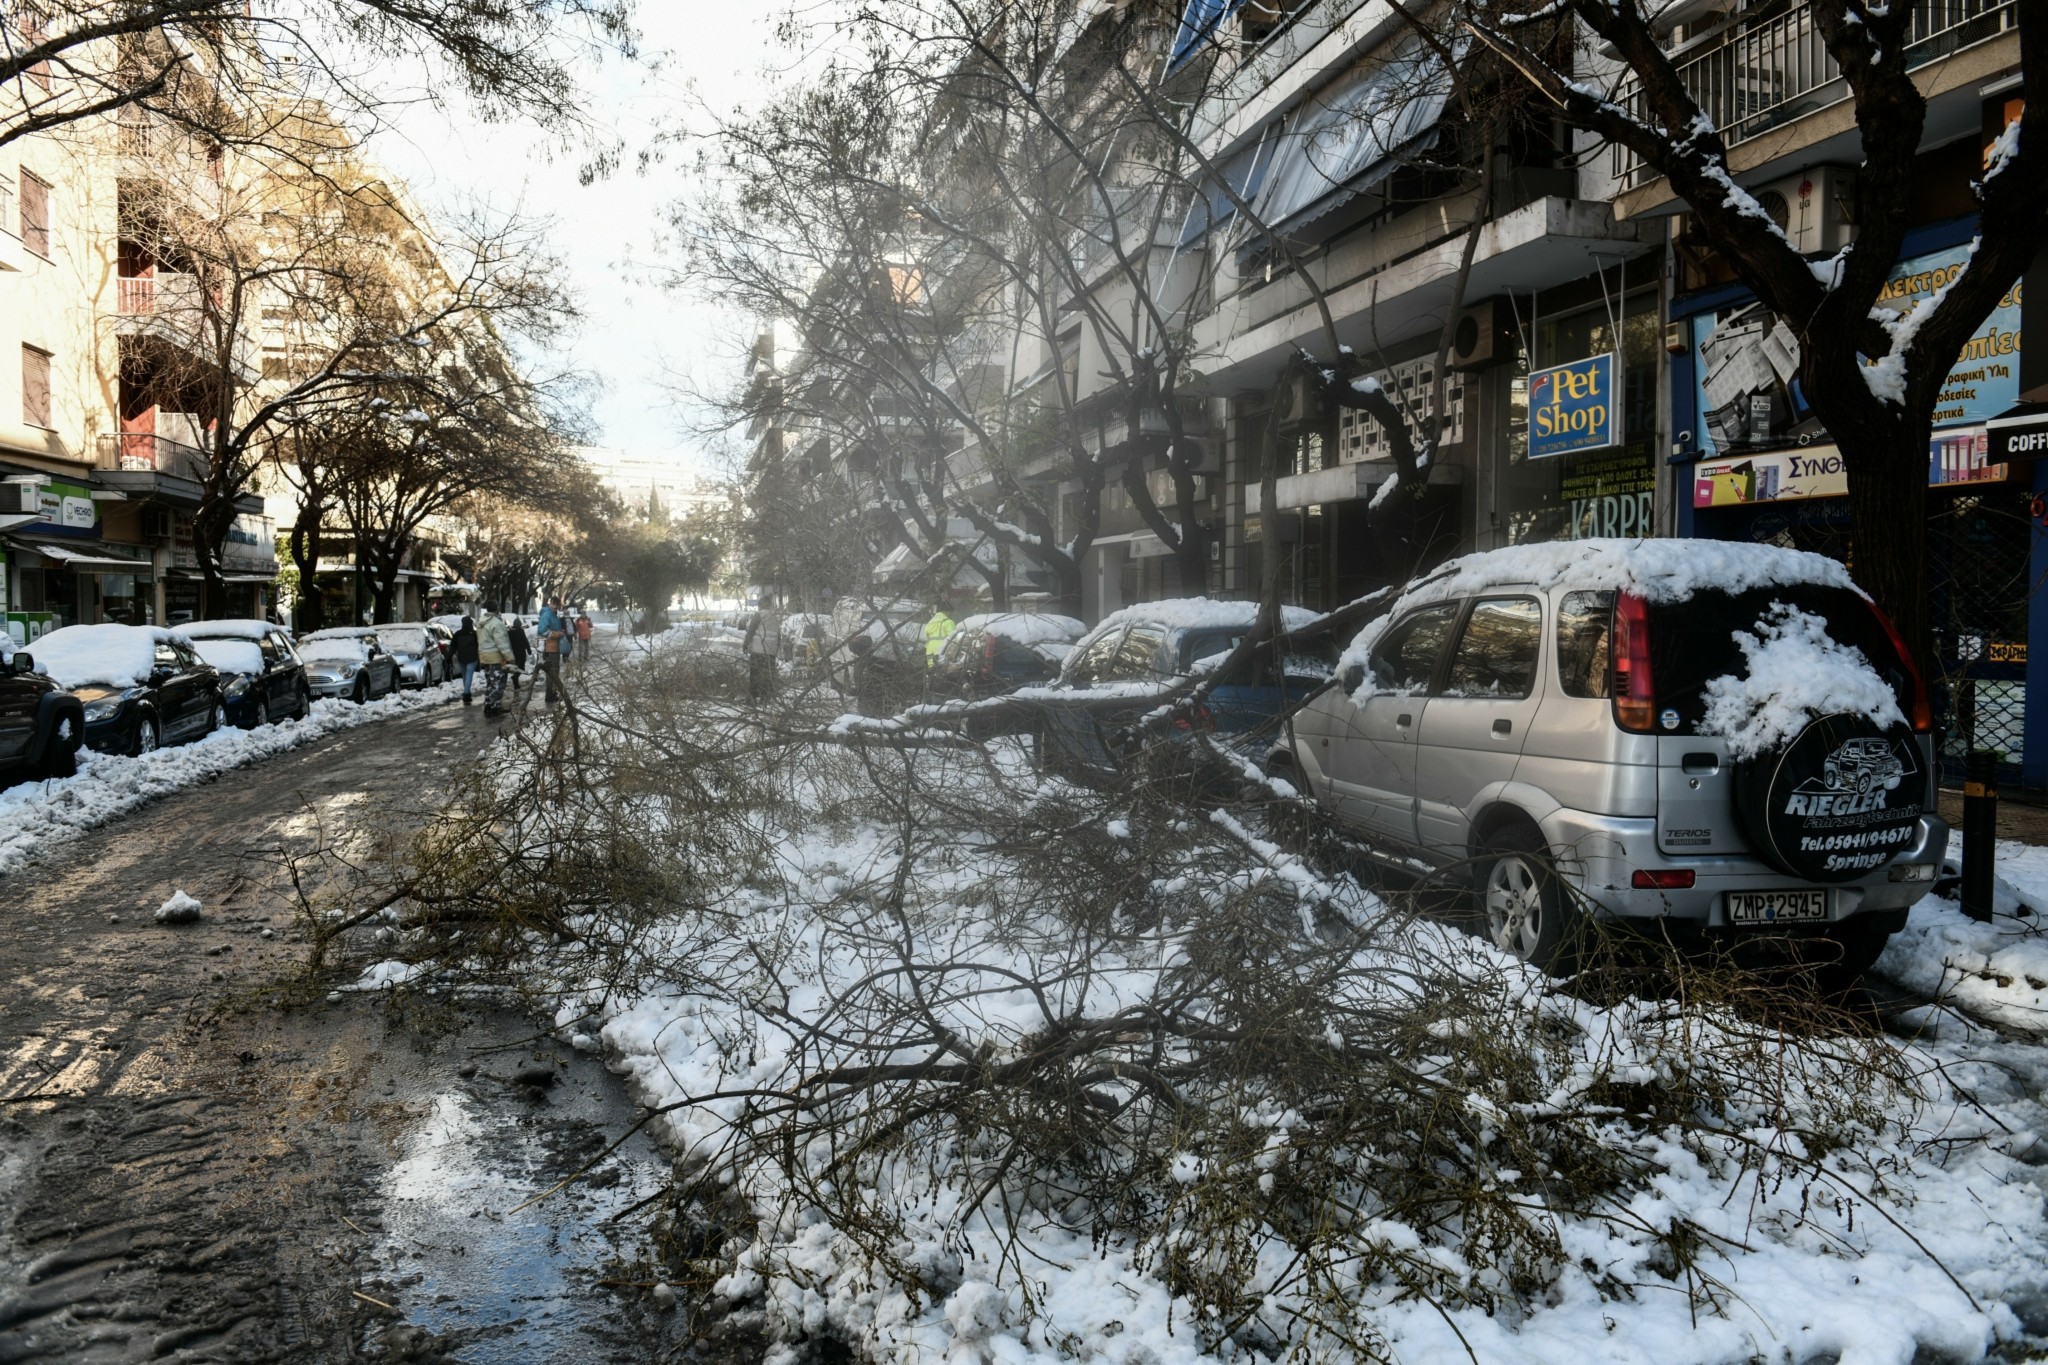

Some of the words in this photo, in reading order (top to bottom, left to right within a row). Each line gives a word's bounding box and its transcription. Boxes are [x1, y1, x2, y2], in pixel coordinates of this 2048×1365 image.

[1799, 199, 1811, 210] LG
[1878, 263, 1966, 301] λεκτρο
[1550, 363, 1601, 405] Pet
[1942, 367, 1985, 386] ραφική
[1987, 364, 2009, 378] Ύλη
[1536, 404, 1606, 438] Shop
[1931, 406, 1964, 422] αρτικά
[1812, 427, 1828, 439] Shift
[1784, 790, 1887, 817] RIEGLER
[1666, 829, 1711, 838] TERIOS
[1823, 852, 1887, 871] Springe
[1732, 894, 1765, 920] ZMP
[1776, 893, 1822, 918] 2945
